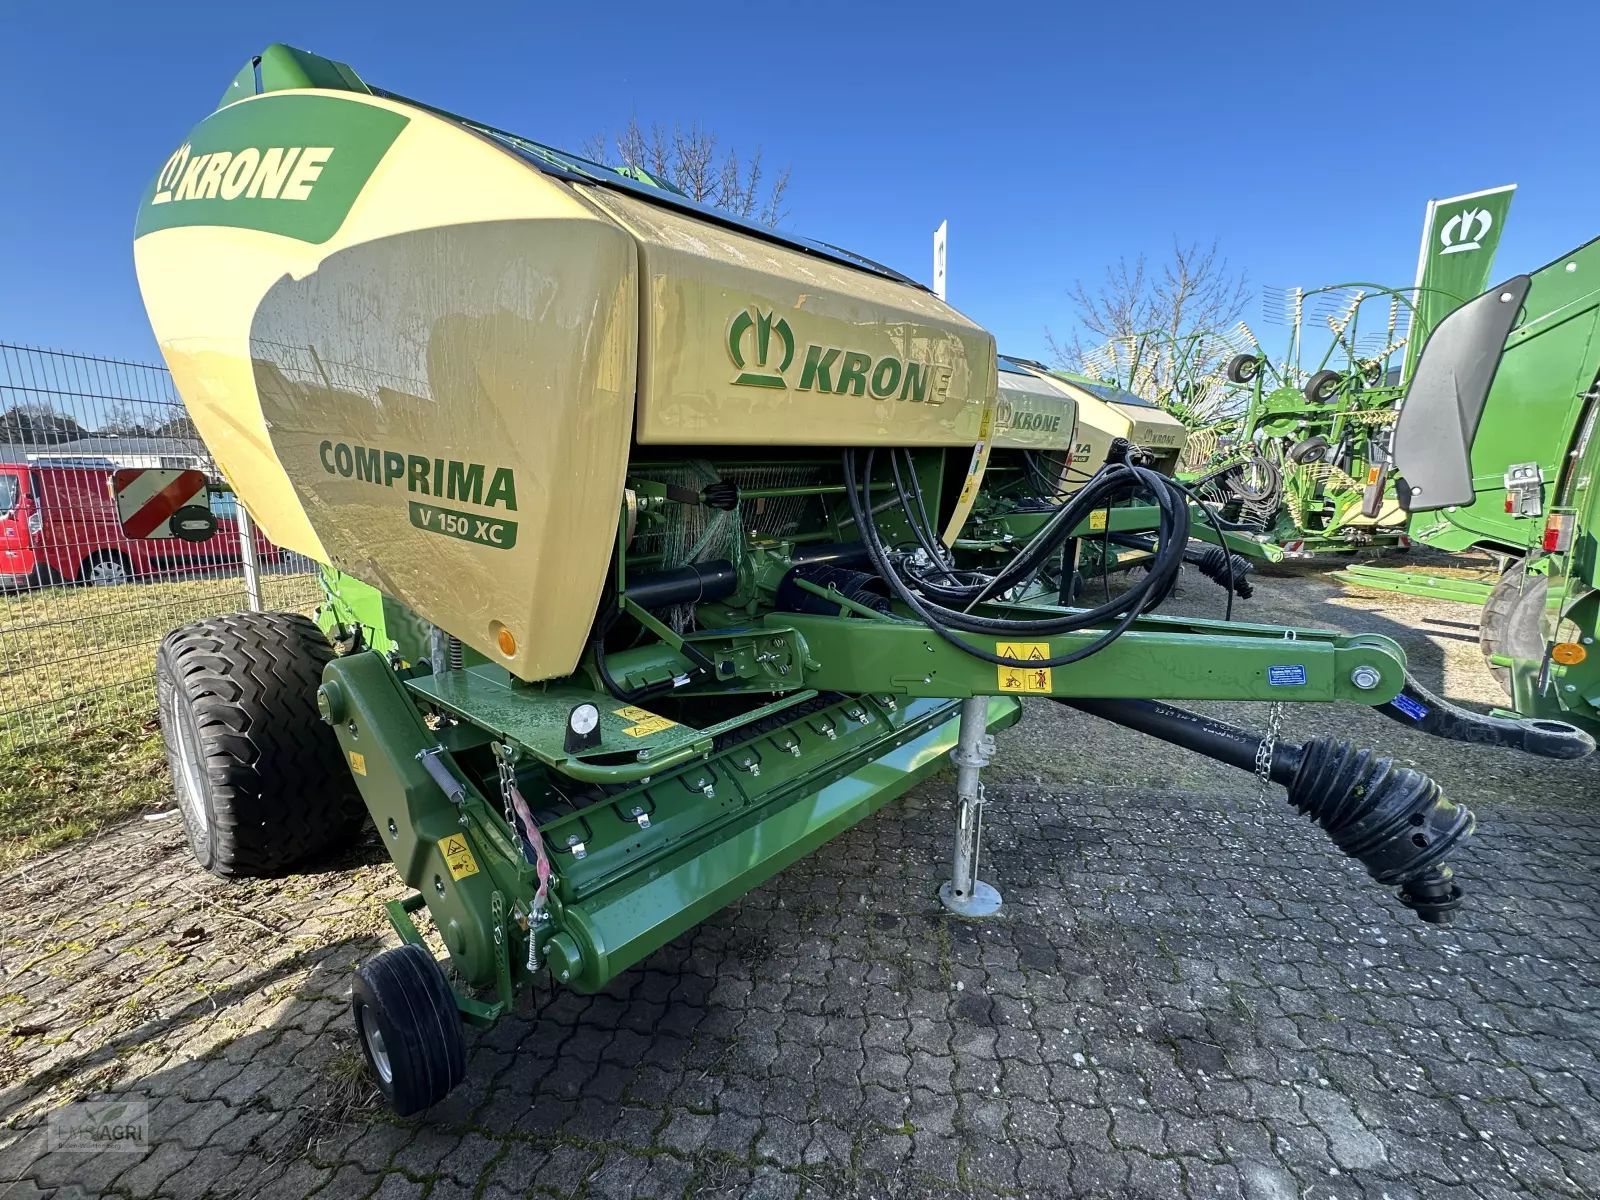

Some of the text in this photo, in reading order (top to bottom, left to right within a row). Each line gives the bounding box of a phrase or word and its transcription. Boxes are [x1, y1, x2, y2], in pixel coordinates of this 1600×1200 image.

[174, 147, 335, 201] KRONE
[796, 344, 953, 405] KRONE
[1011, 411, 1061, 433] KRONE
[319, 439, 518, 511] COMPRIMA
[419, 508, 504, 544] V 150 XC
